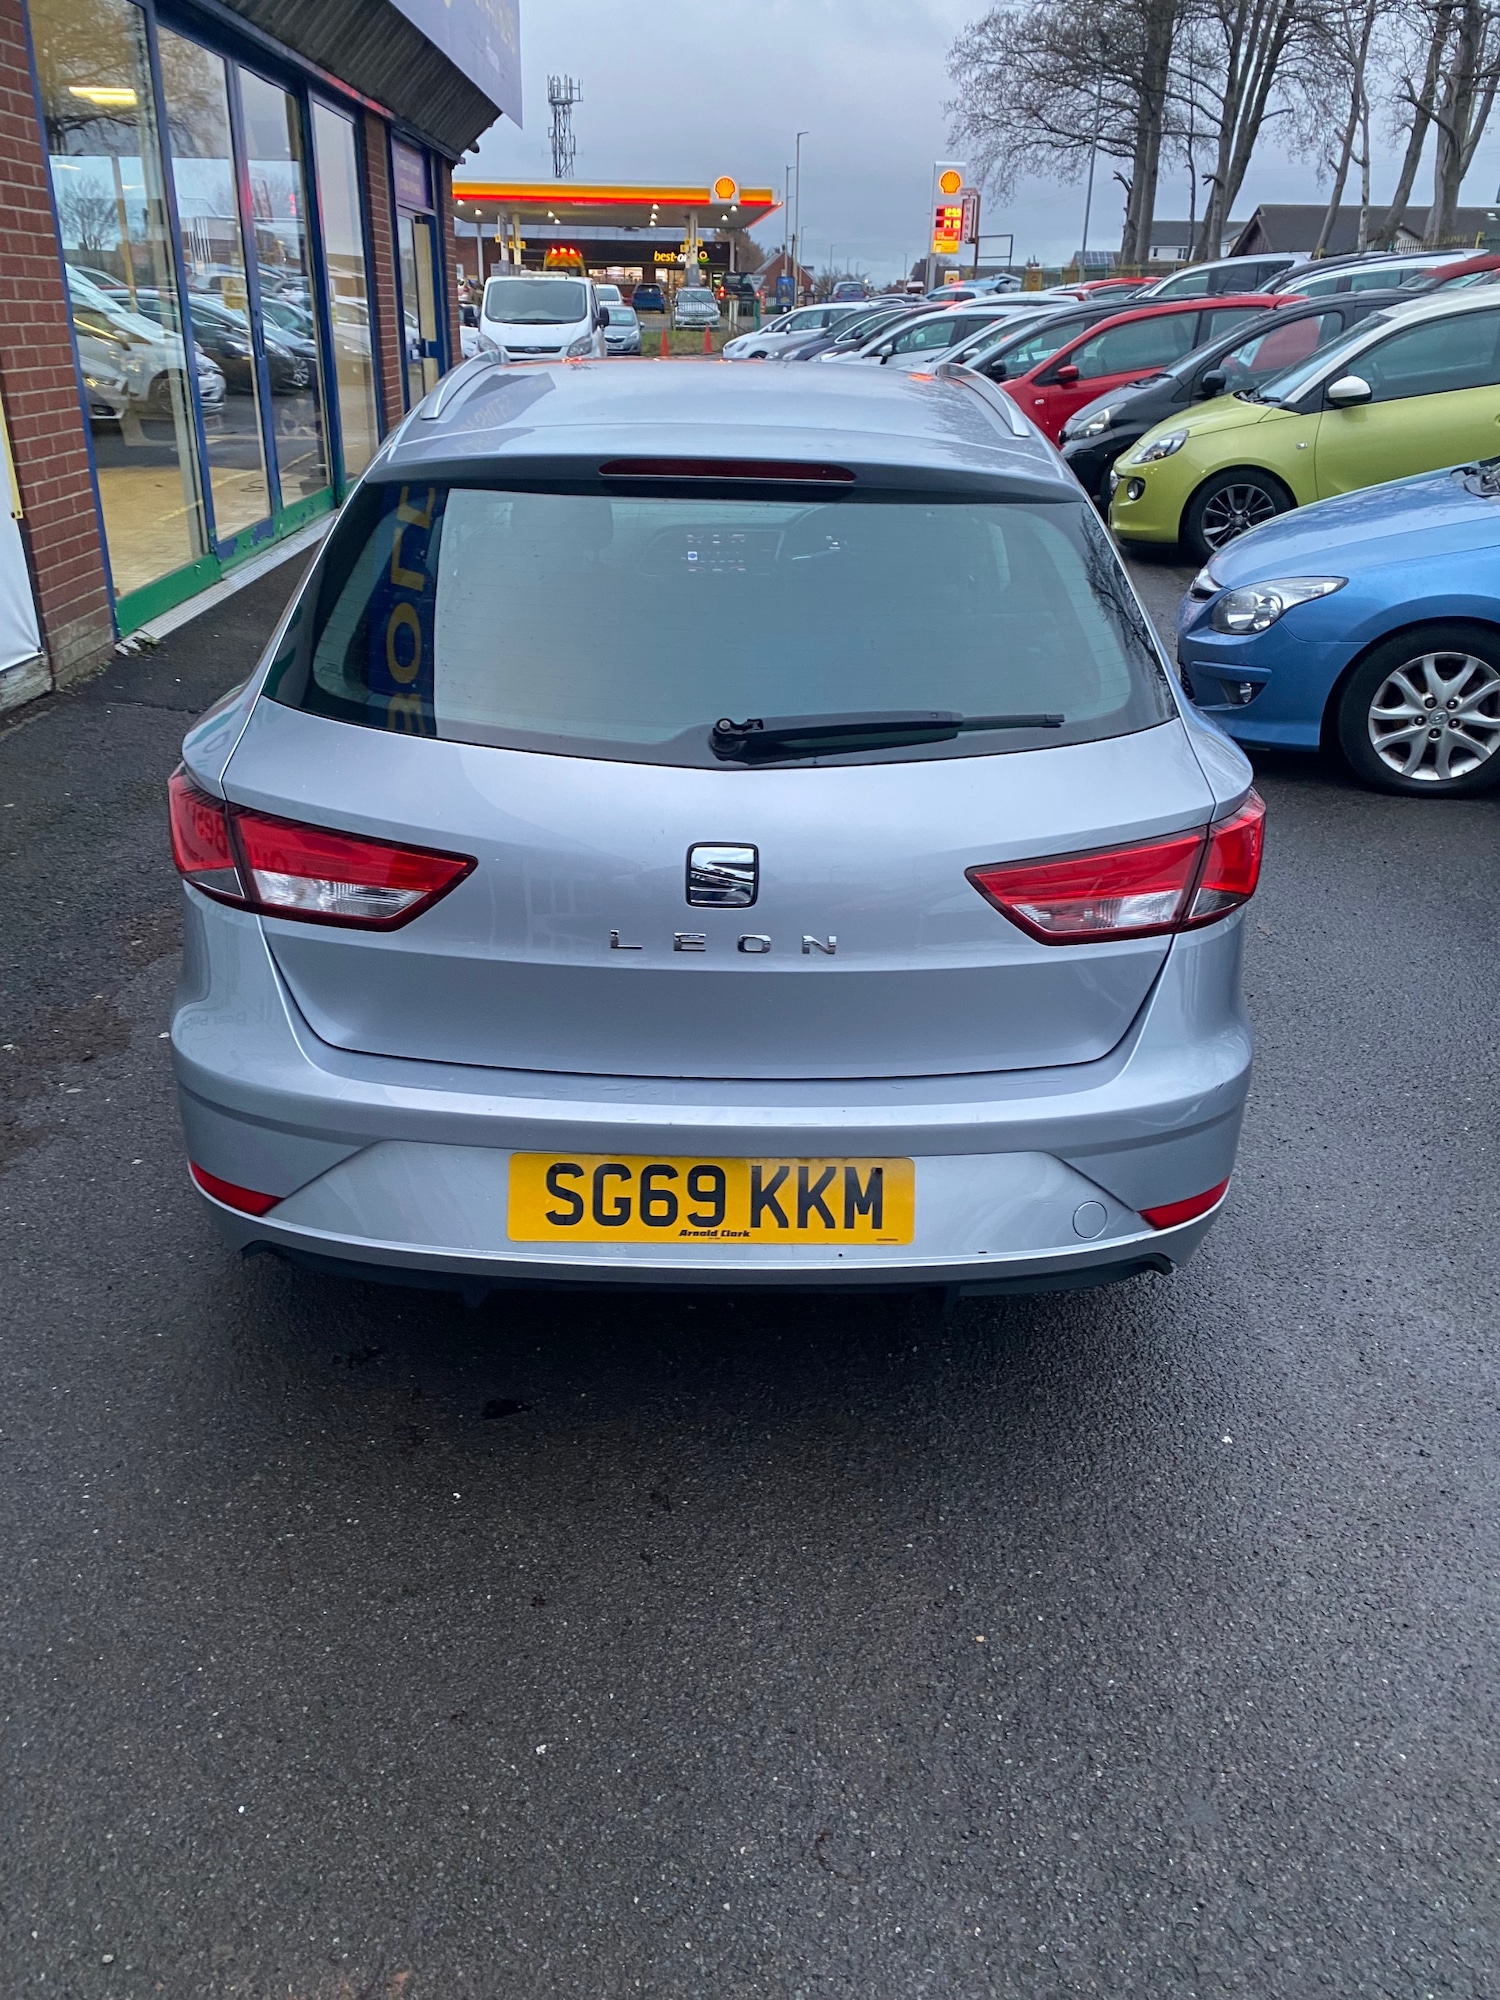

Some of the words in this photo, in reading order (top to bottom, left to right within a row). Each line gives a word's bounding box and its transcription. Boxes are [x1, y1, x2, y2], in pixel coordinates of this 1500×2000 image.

[653, 250, 687, 263] best-o
[610, 929, 837, 955] LEON
[545, 1162, 726, 1228] SG69
[750, 1165, 883, 1230] KKM
[678, 1229, 718, 1237] Arnold
[721, 1229, 750, 1238] Clark
